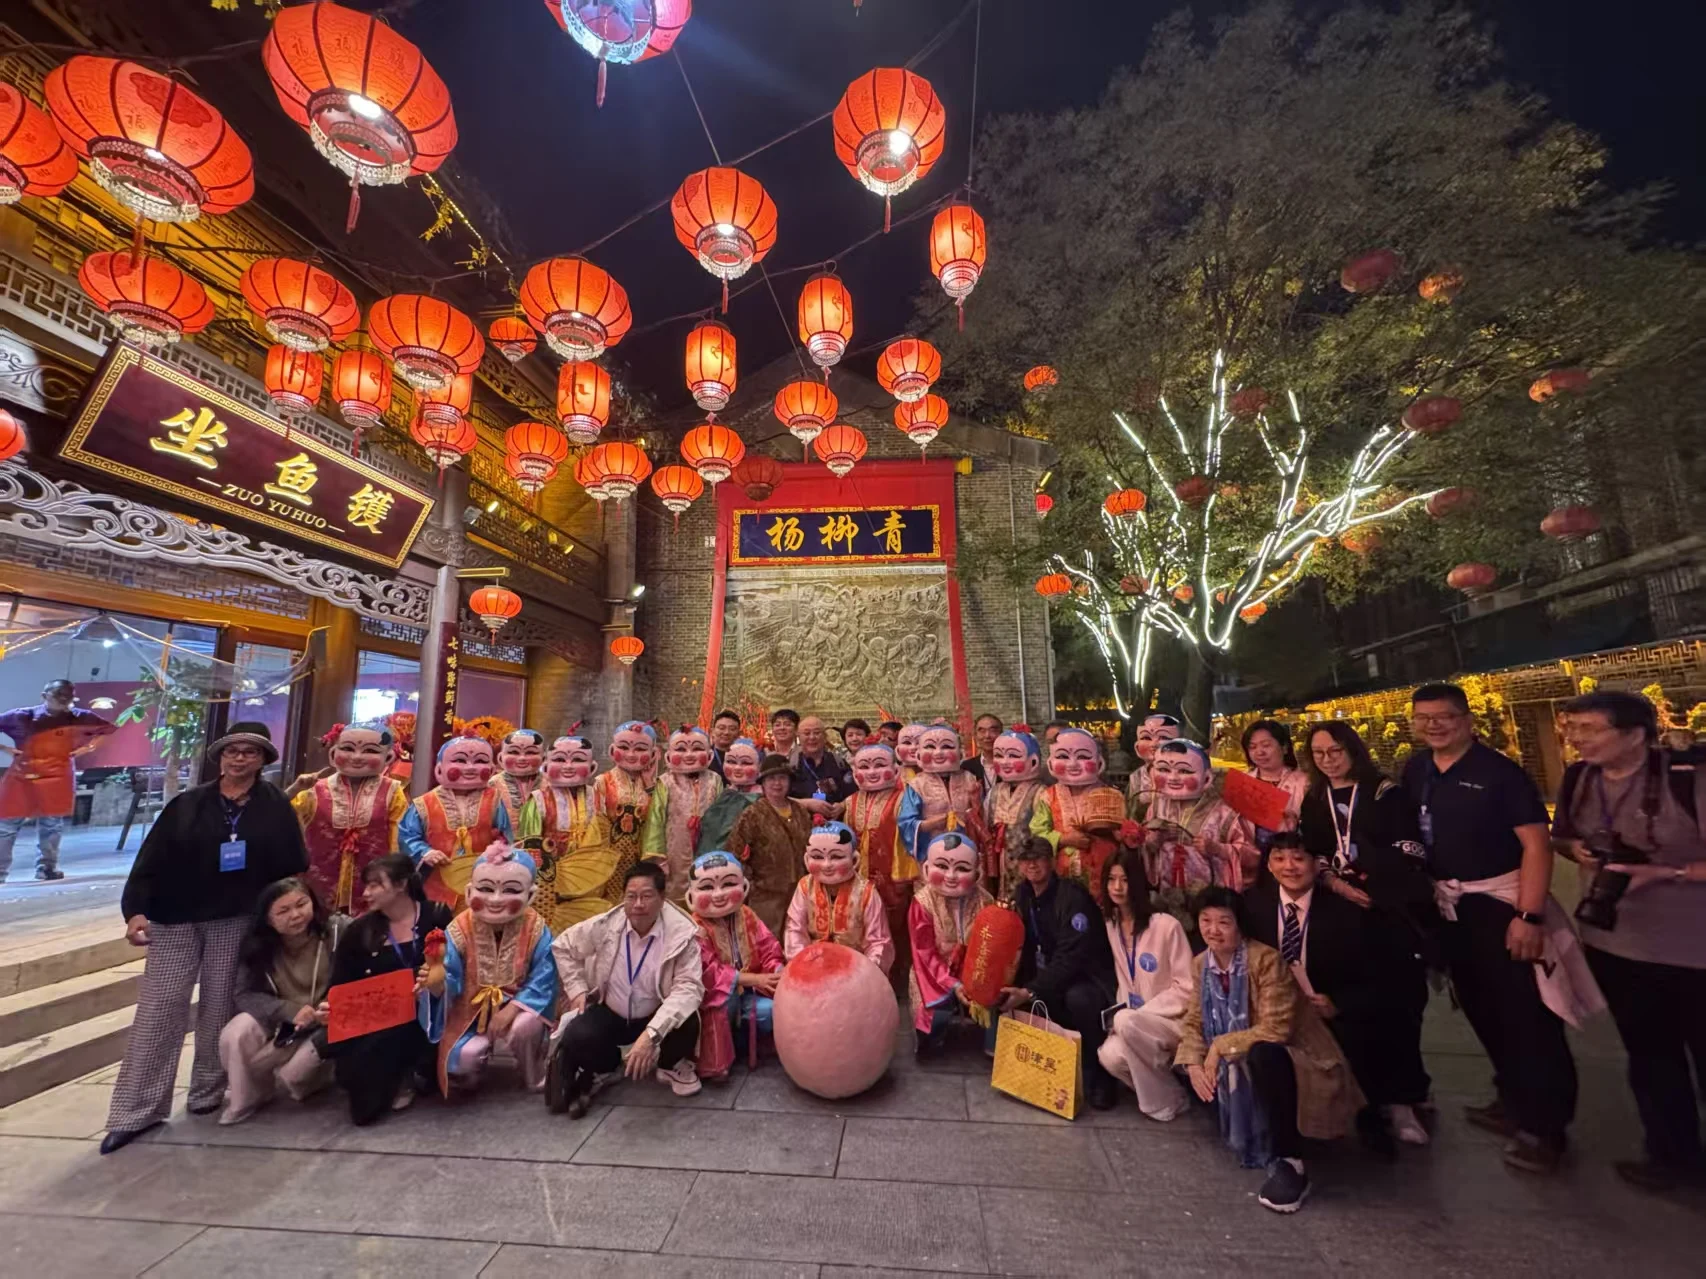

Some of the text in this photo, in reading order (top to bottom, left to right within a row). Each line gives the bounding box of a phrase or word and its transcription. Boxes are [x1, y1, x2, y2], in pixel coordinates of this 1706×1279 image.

[150, 407, 395, 534] 坐鱼镬
[222, 484, 264, 506] ZUO
[765, 511, 906, 554] 杨柳青
